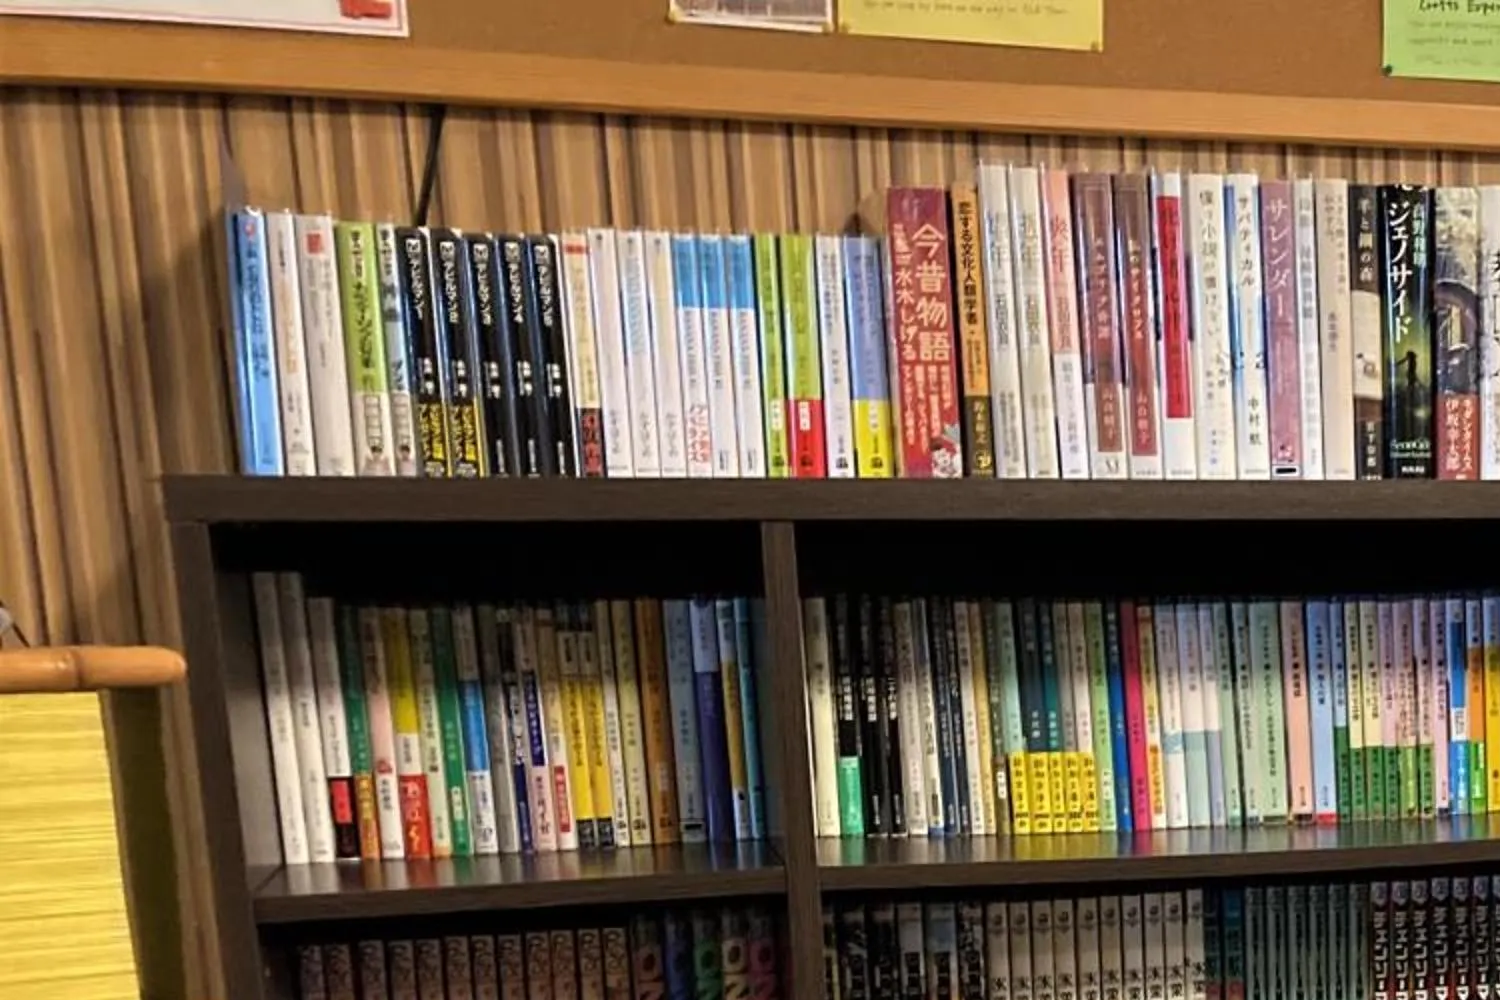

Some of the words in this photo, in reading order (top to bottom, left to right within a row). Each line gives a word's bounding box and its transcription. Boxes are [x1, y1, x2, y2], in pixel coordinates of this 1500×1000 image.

[911, 222, 952, 362] 今昔物語
[1265, 201, 1292, 317] サレンダー
[1389, 201, 1414, 343] ジェノサイド
